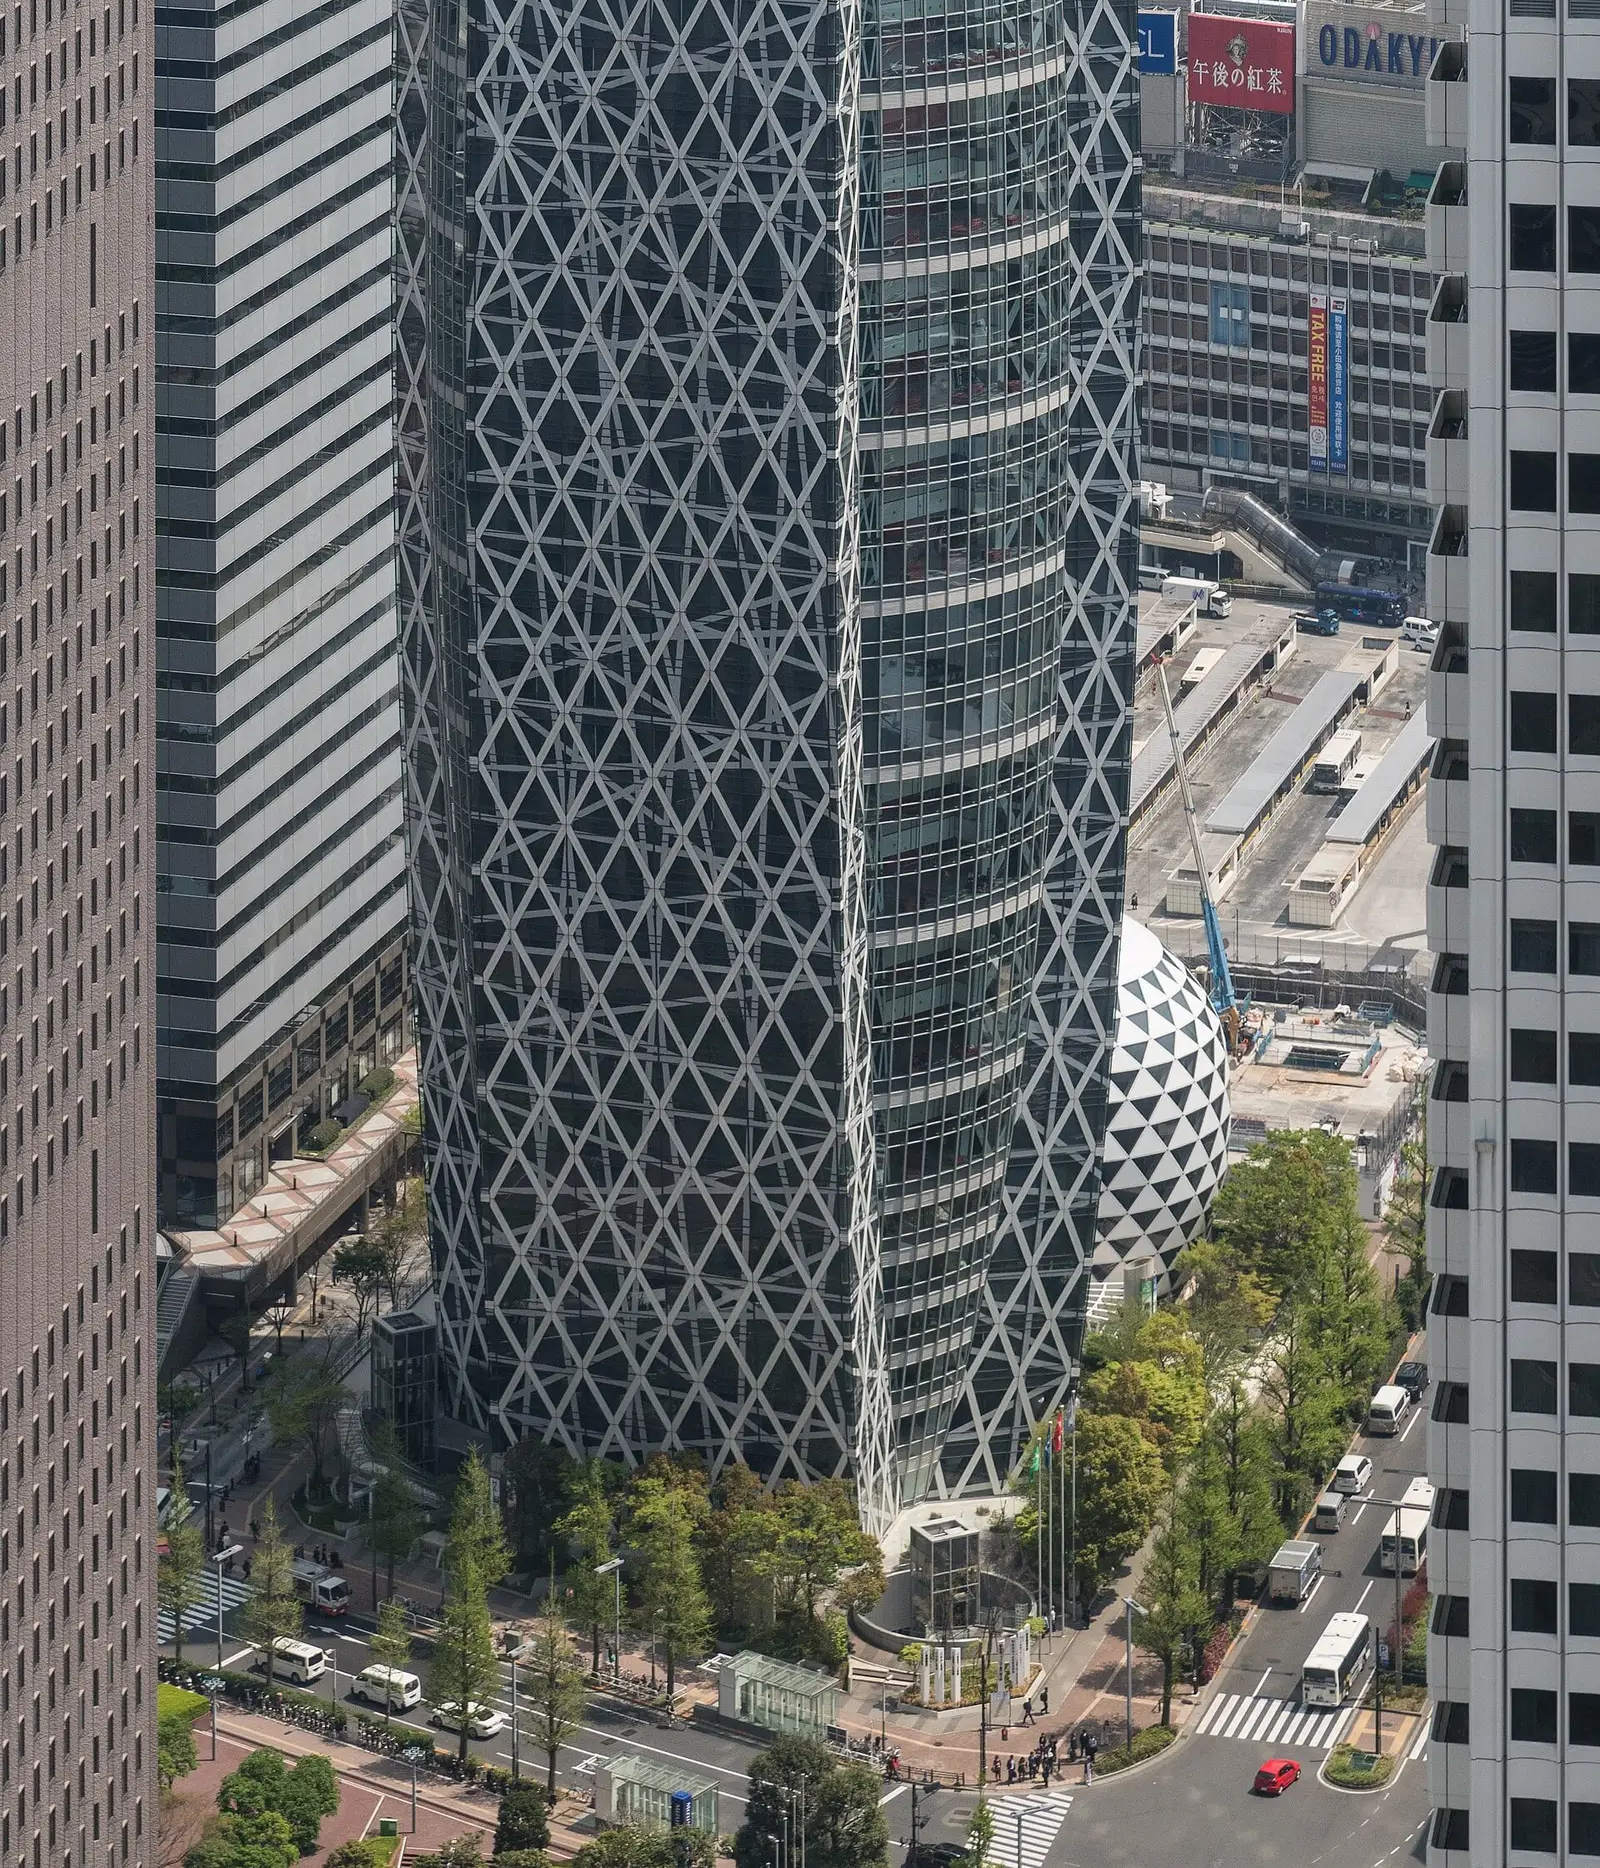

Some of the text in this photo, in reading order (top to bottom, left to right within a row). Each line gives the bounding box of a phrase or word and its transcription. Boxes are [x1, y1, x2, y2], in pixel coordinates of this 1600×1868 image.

[1193, 58, 1283, 94] 午後の紅茶
[1312, 313, 1324, 382] TAX FREE
